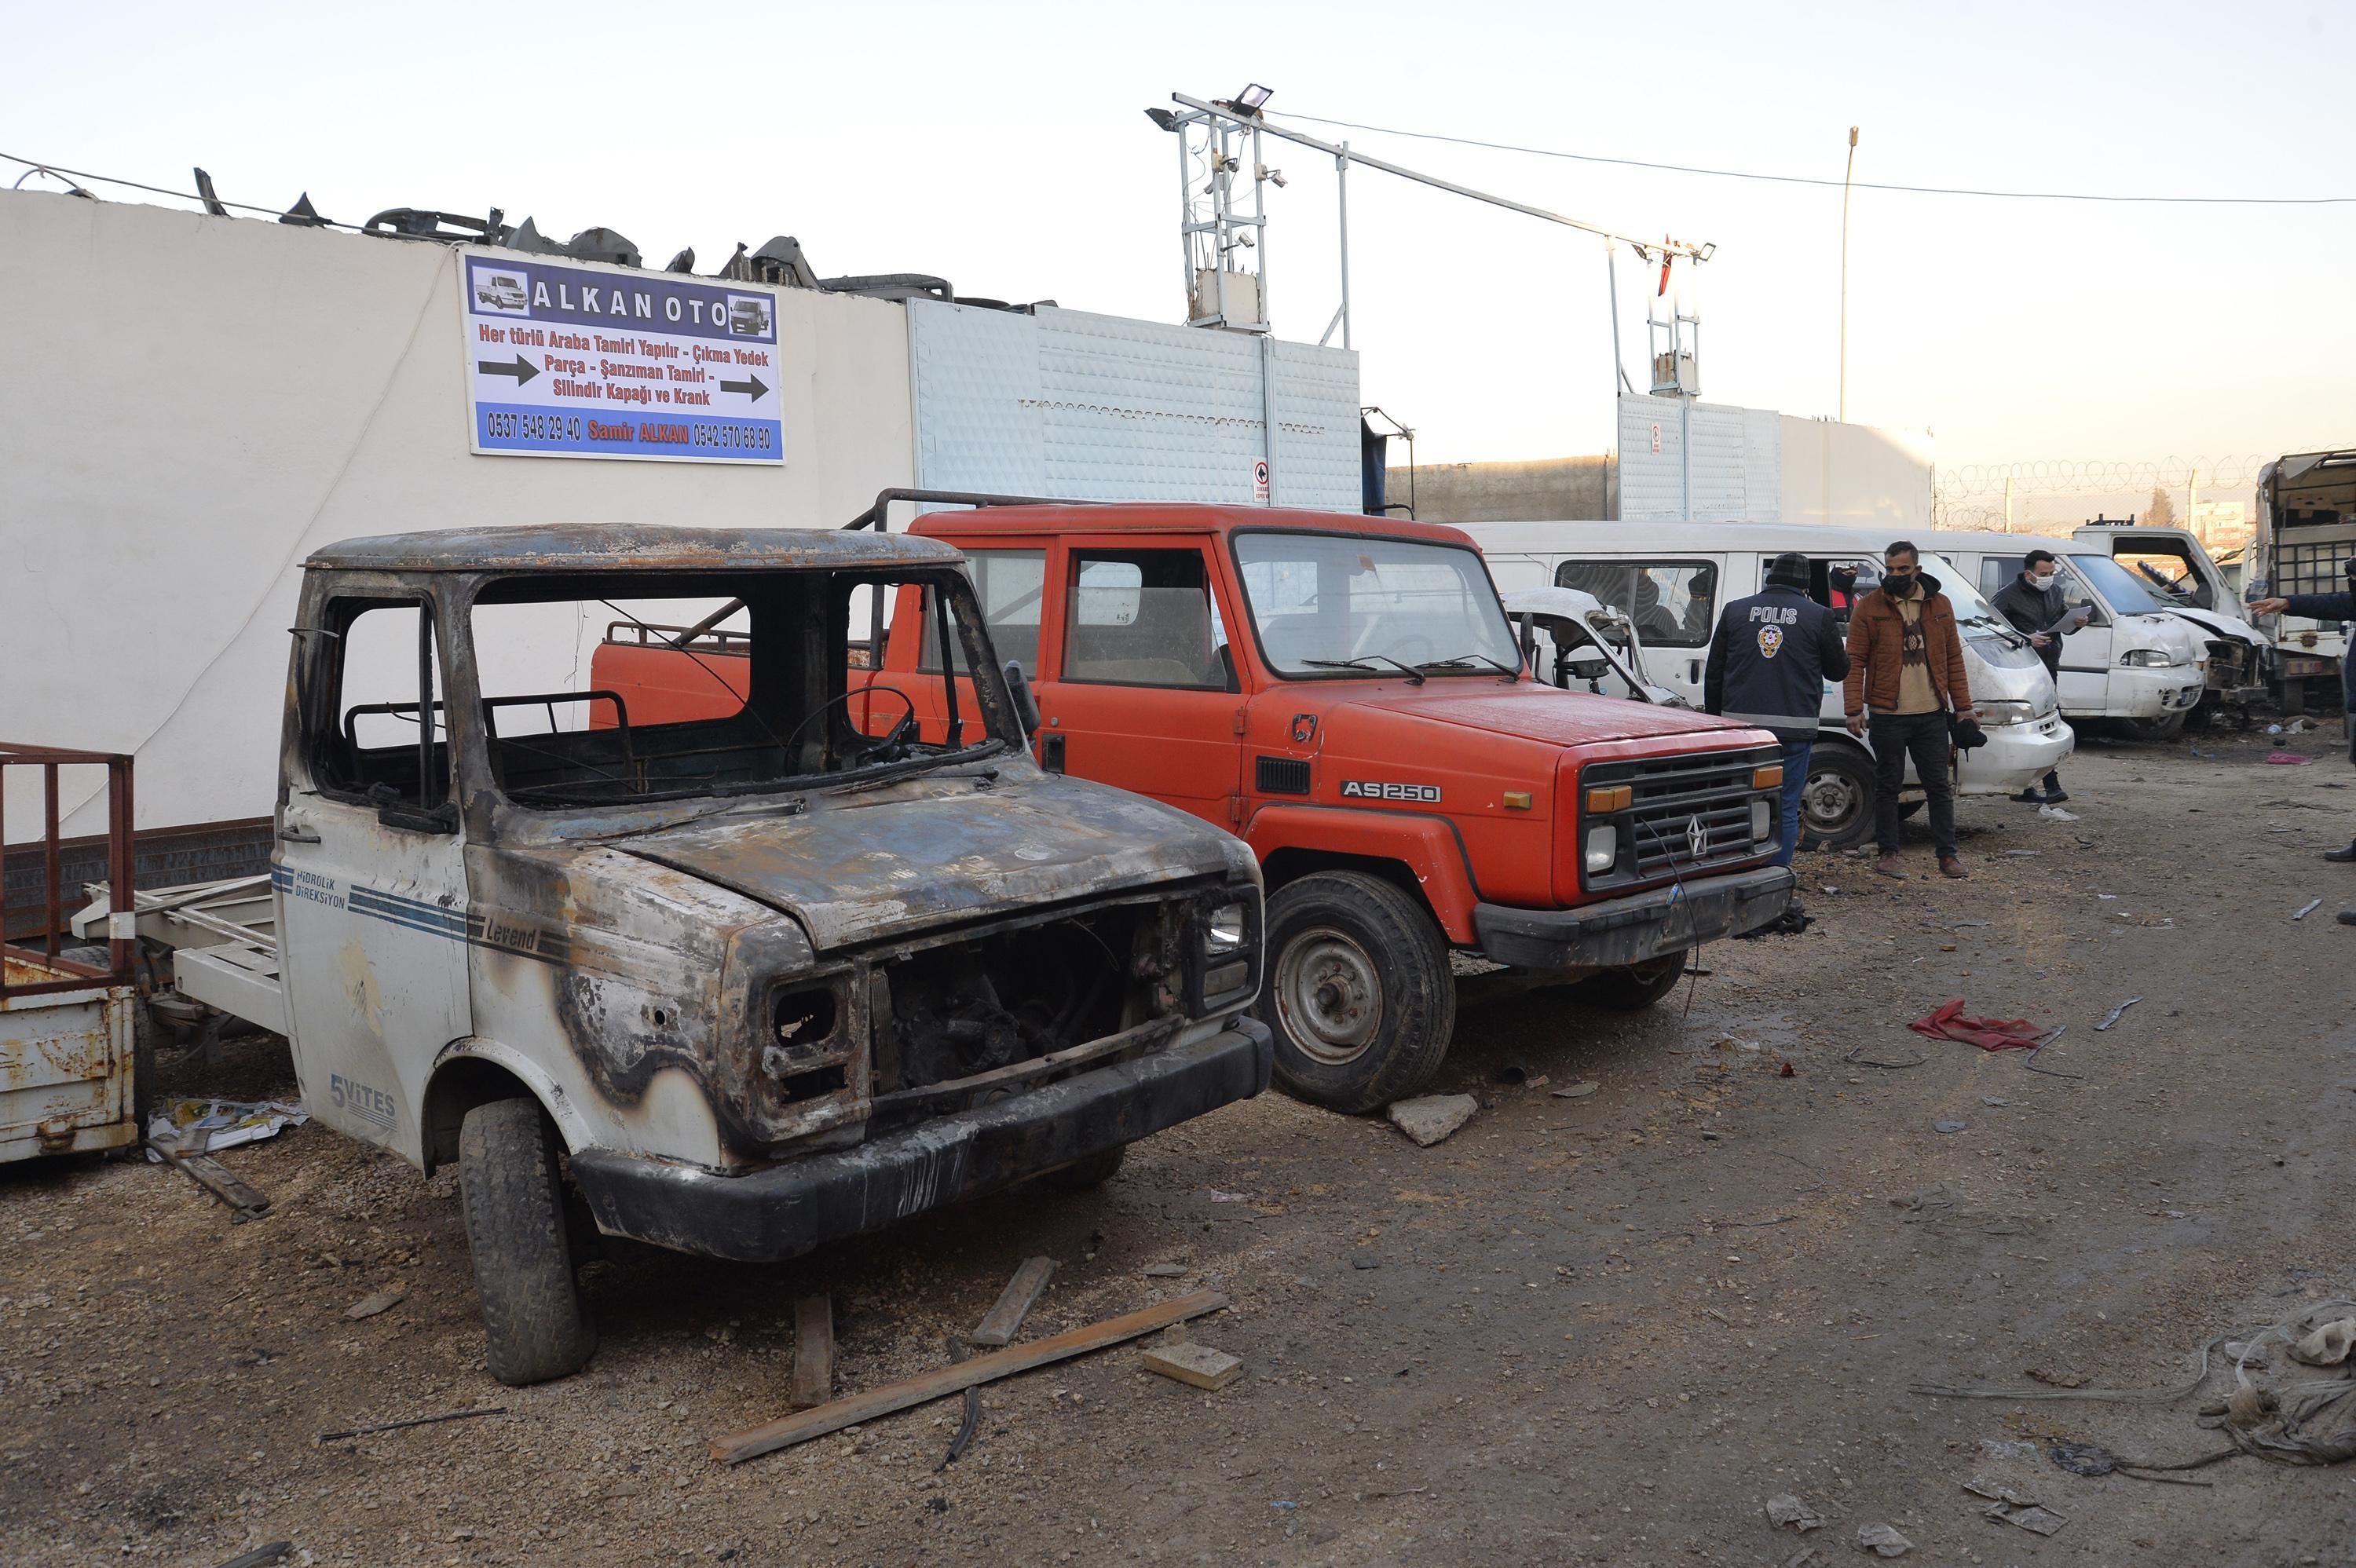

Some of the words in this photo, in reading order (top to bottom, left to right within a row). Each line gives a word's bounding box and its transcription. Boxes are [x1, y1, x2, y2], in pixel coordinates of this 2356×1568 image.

[533, 281, 651, 318] ALKAN
[665, 297, 726, 327] OTO
[479, 324, 505, 342] Her
[510, 327, 544, 346] türlü
[549, 331, 590, 351] Araba
[594, 335, 635, 354] Tamiri
[734, 349, 769, 367] Yedek
[544, 354, 586, 377] Parça
[667, 364, 705, 383] Tamiri
[553, 379, 602, 398] Silindir
[655, 390, 669, 403] ve
[674, 388, 710, 405] Krank
[488, 411, 518, 438] 0537
[522, 414, 544, 440] 548
[548, 415, 562, 440] 29
[566, 416, 581, 441] 40
[588, 419, 634, 441] Samir
[639, 422, 689, 444] ALKAN
[693, 423, 719, 447] 0542
[722, 426, 741, 448] 570
[744, 426, 755, 449] 68
[759, 427, 770, 450] 90
[487, 918, 536, 950] Levend
